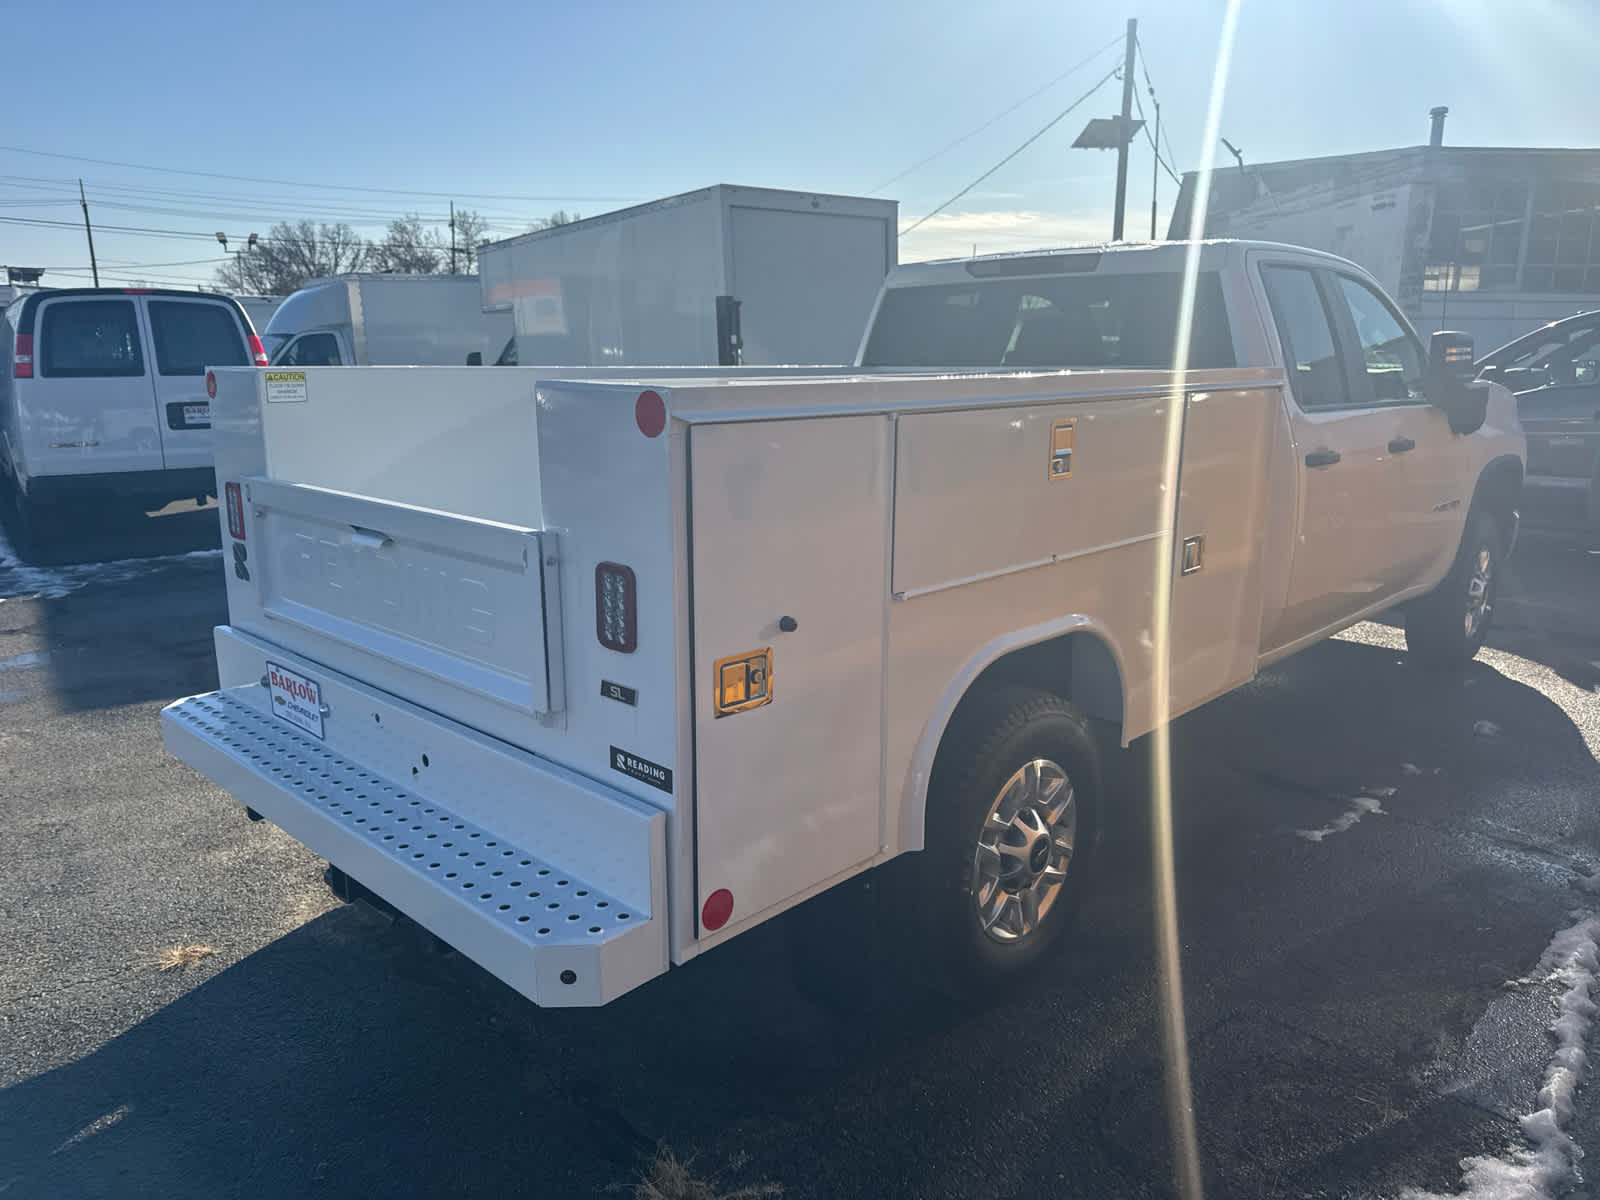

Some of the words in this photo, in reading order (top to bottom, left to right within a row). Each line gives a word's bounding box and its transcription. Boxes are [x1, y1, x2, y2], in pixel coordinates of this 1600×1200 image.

[270, 671, 317, 704] BARLOW
[610, 686, 625, 700] SL
[627, 757, 665, 780] READING
